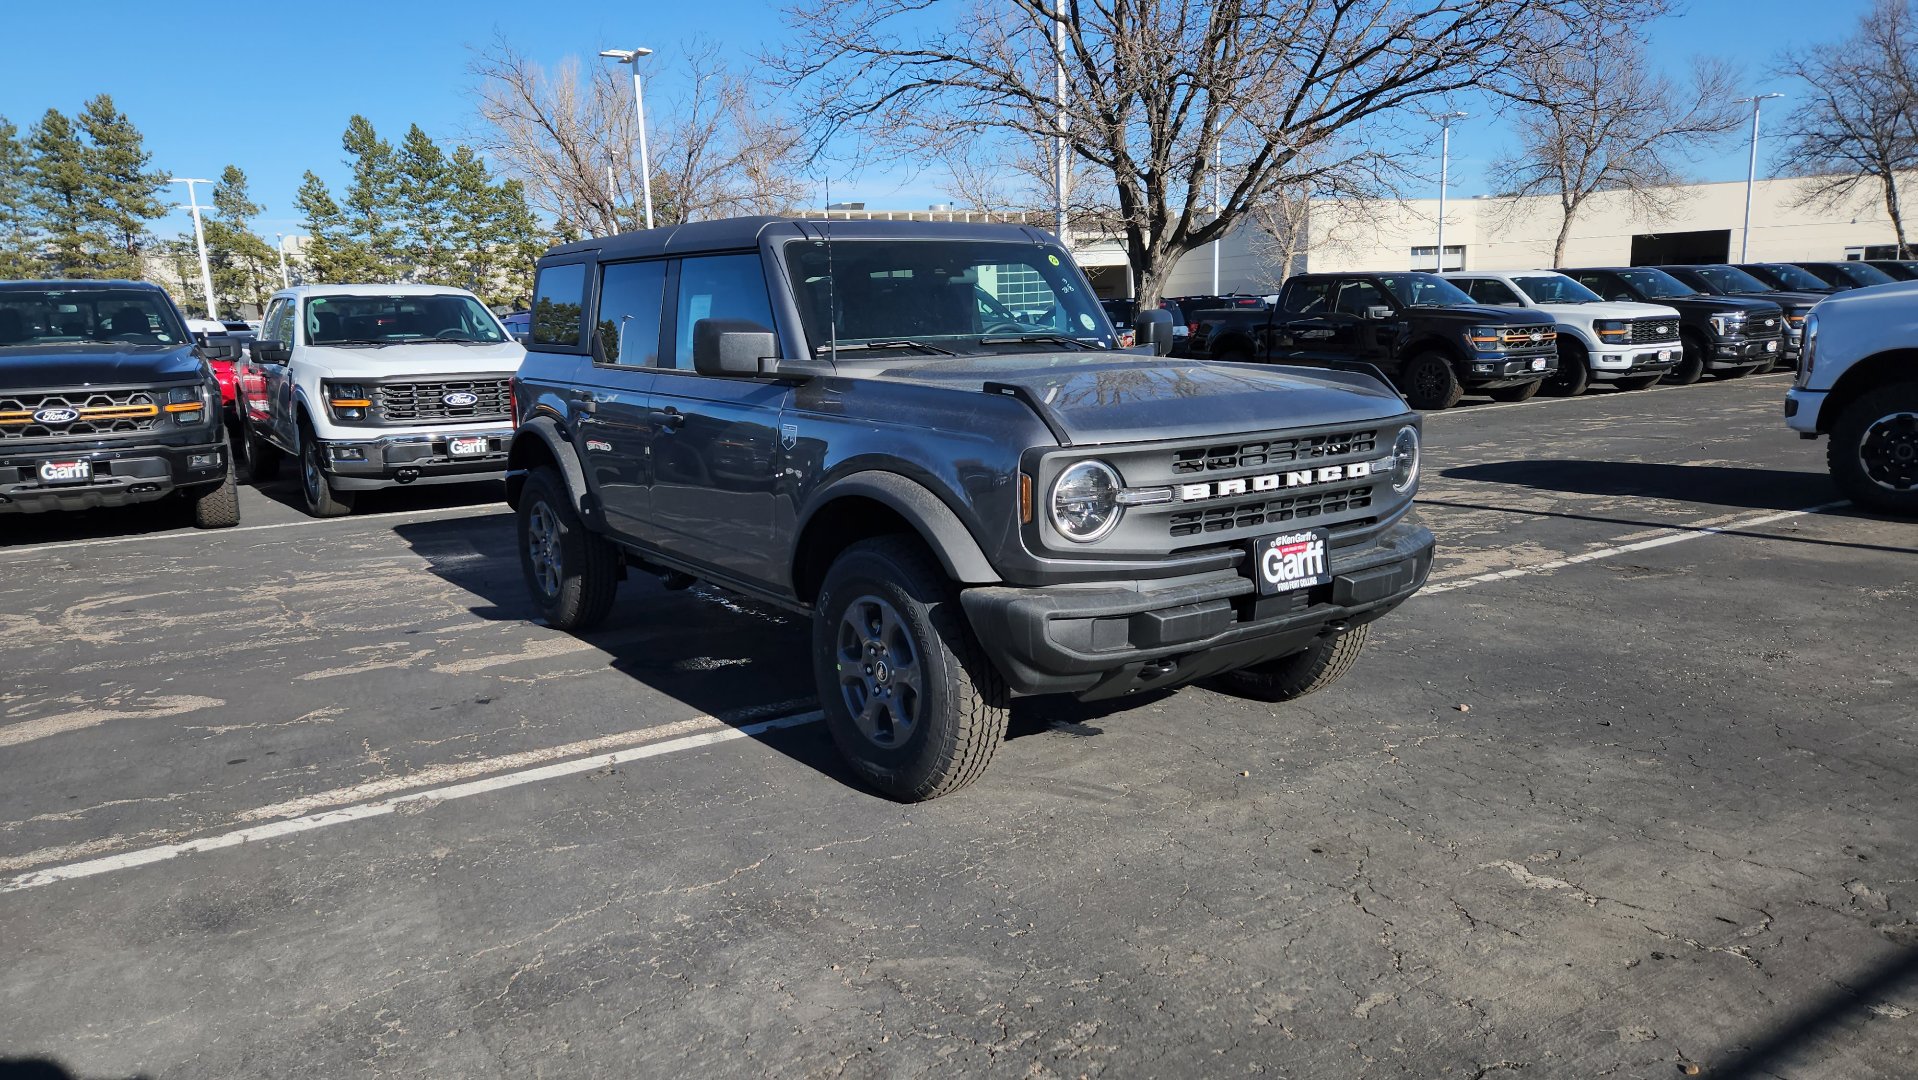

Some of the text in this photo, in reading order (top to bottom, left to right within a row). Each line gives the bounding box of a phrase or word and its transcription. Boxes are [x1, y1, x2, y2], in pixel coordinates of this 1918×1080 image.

[451, 395, 472, 404] Ford
[43, 410, 70, 420] Ford
[450, 438, 487, 454] Garff
[41, 461, 89, 479] Garff
[1183, 462, 1370, 500] BRONCO
[1262, 540, 1324, 584] Garff
